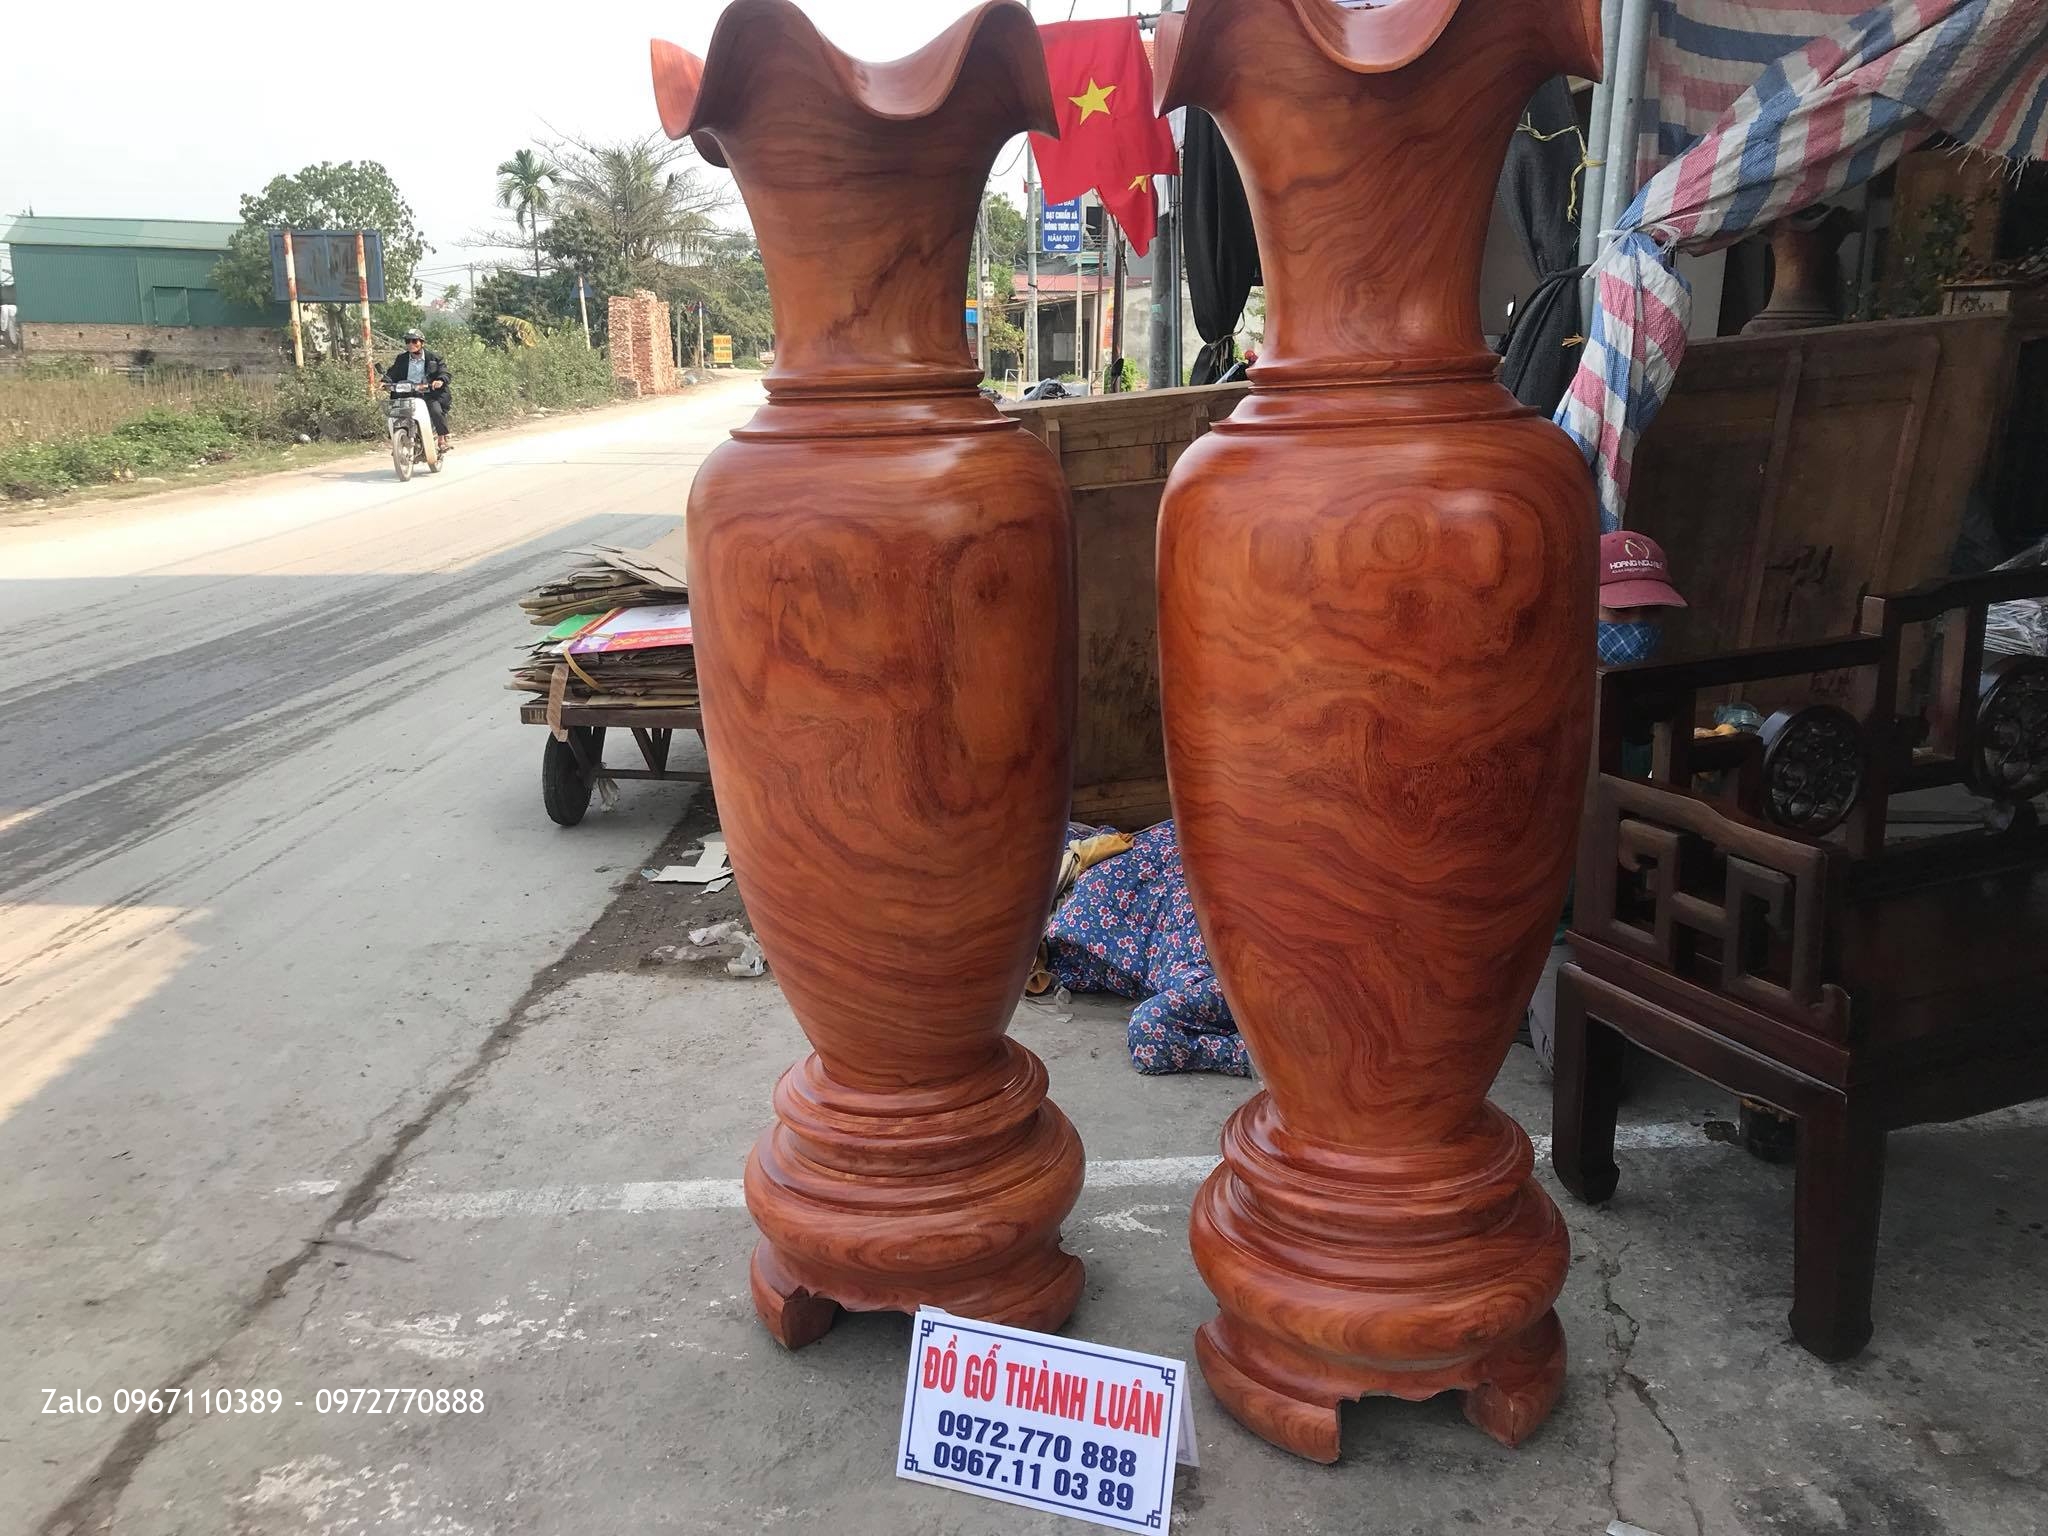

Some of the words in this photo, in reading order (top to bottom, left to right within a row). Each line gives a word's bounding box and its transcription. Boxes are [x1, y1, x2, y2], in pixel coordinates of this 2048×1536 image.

[1047, 233, 1062, 242] NĂM
[923, 1334, 958, 1393] ĐỒ
[963, 1344, 1002, 1402] GỖ
[1005, 1359, 1088, 1422] THÀNH
[1093, 1379, 1165, 1438] LUÂN
[933, 1441, 1042, 1490] 0967.11
[1053, 1468, 1088, 1501] 03
[1097, 1478, 1135, 1511] 89
[938, 1409, 1072, 1463] 0972.770
[1080, 1440, 1137, 1478] 888
